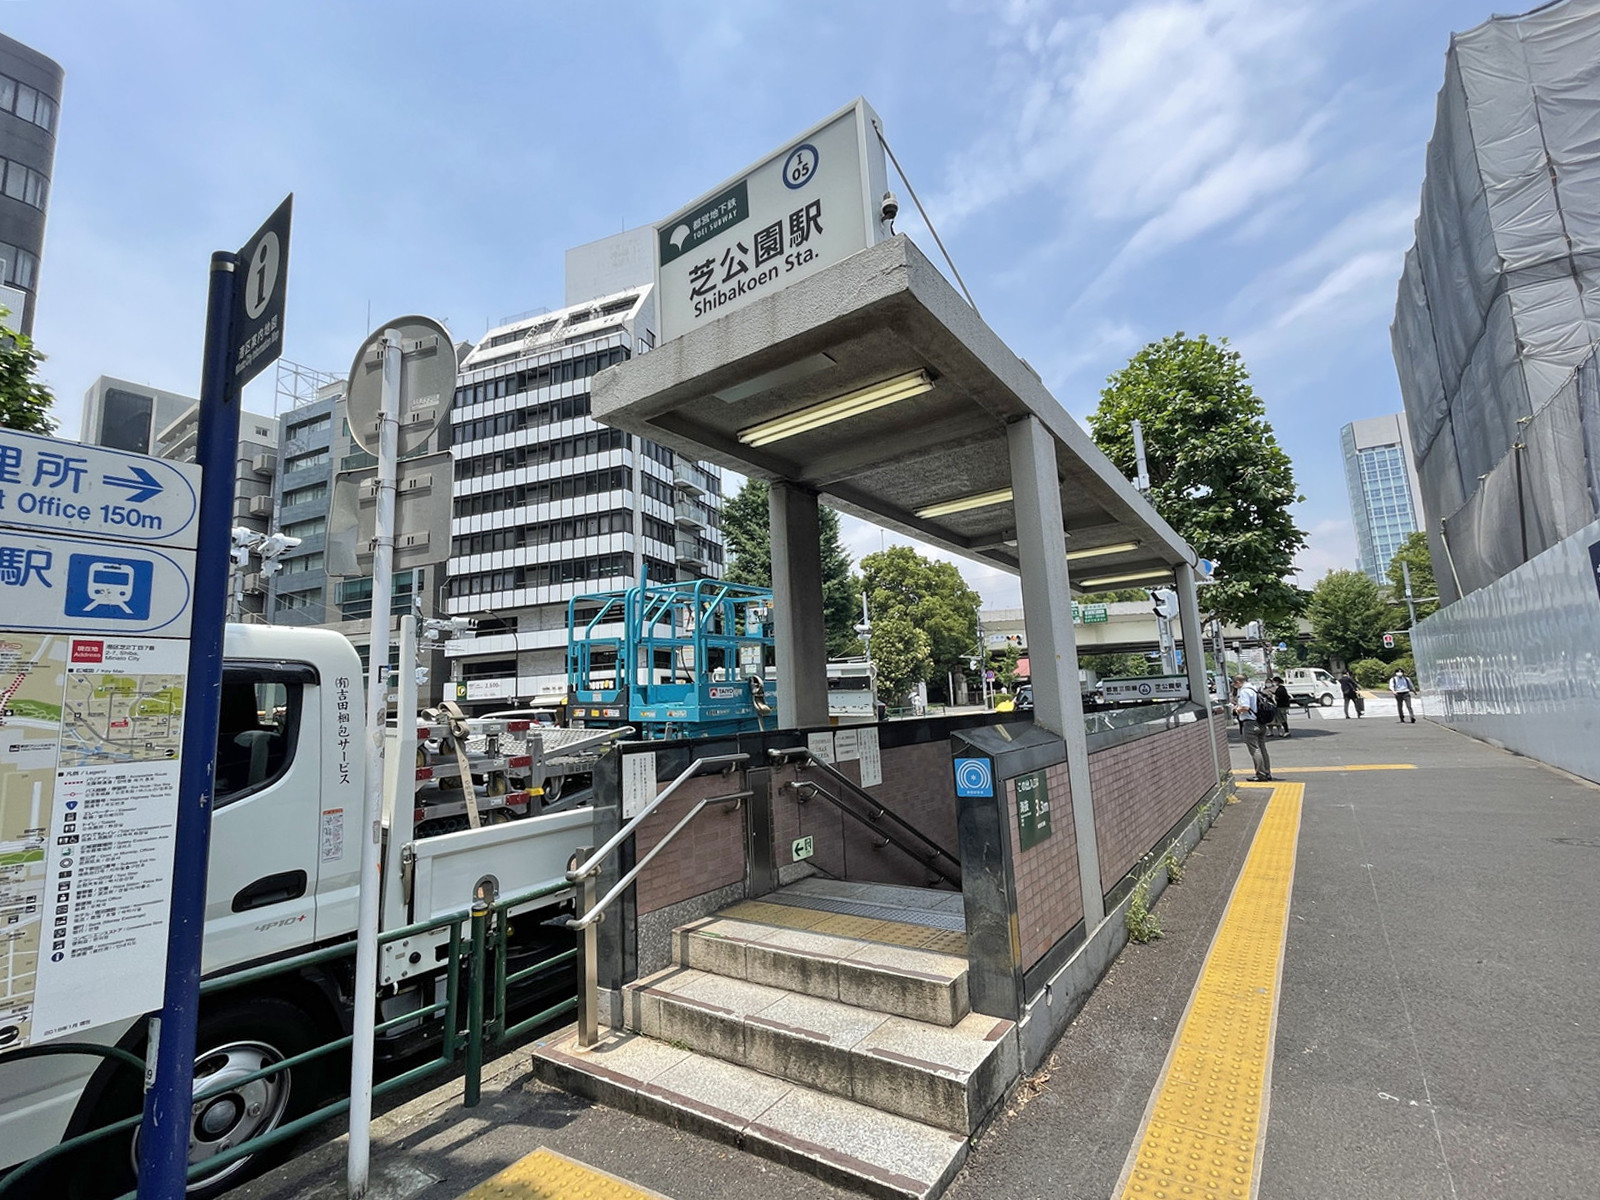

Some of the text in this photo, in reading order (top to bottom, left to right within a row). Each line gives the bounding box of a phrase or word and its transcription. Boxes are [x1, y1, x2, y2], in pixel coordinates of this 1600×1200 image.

[792, 162, 810, 181] 05
[797, 152, 803, 166] I
[693, 209, 737, 240] TOEI SUBWAY
[689, 198, 823, 301] 芝公園駅
[694, 248, 819, 318] Shibakoen Sta.
[18, 492, 91, 520] Office
[100, 504, 162, 530] 150m
